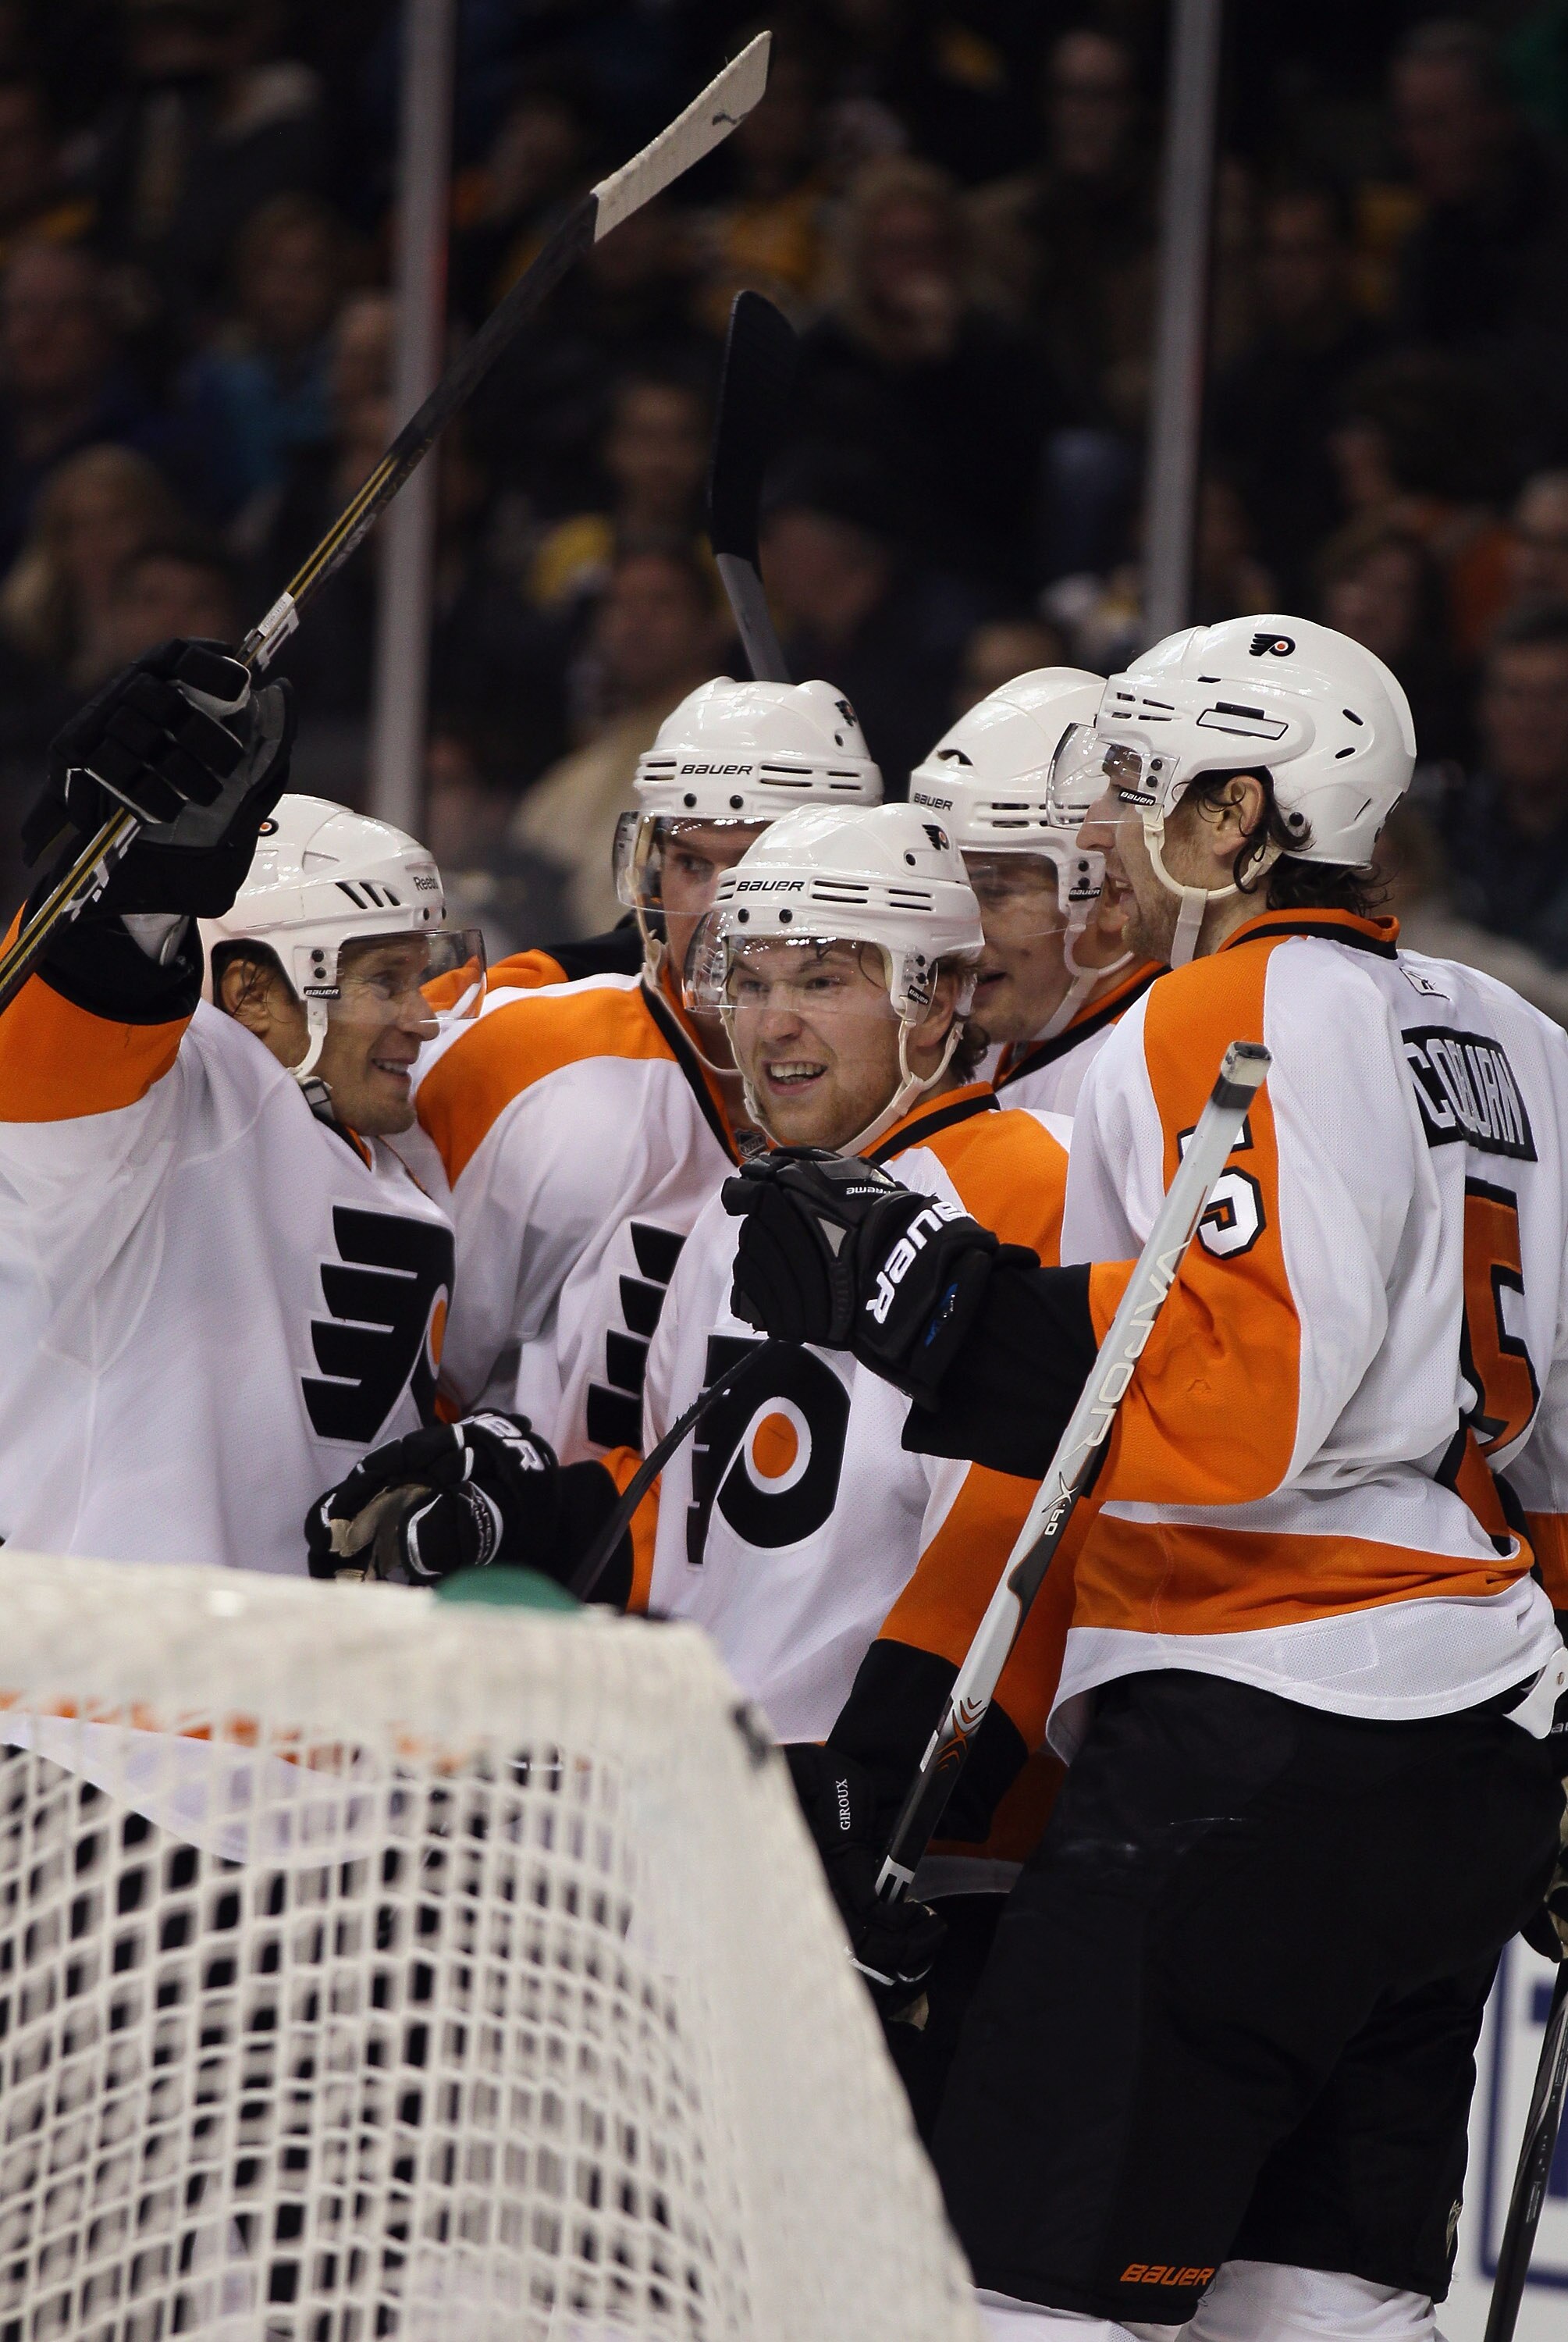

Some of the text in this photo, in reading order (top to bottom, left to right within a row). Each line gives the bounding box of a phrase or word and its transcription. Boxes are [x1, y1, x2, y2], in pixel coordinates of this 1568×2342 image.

[680, 763, 754, 775] BAUER
[913, 792, 955, 812] BAUER
[1119, 791, 1155, 806] BAUER
[735, 880, 806, 892] BAUER
[1061, 1240, 1192, 1462] VAPOR
[835, 1778, 852, 1831] GIROUX
[1119, 2262, 1216, 2287] BAUER
